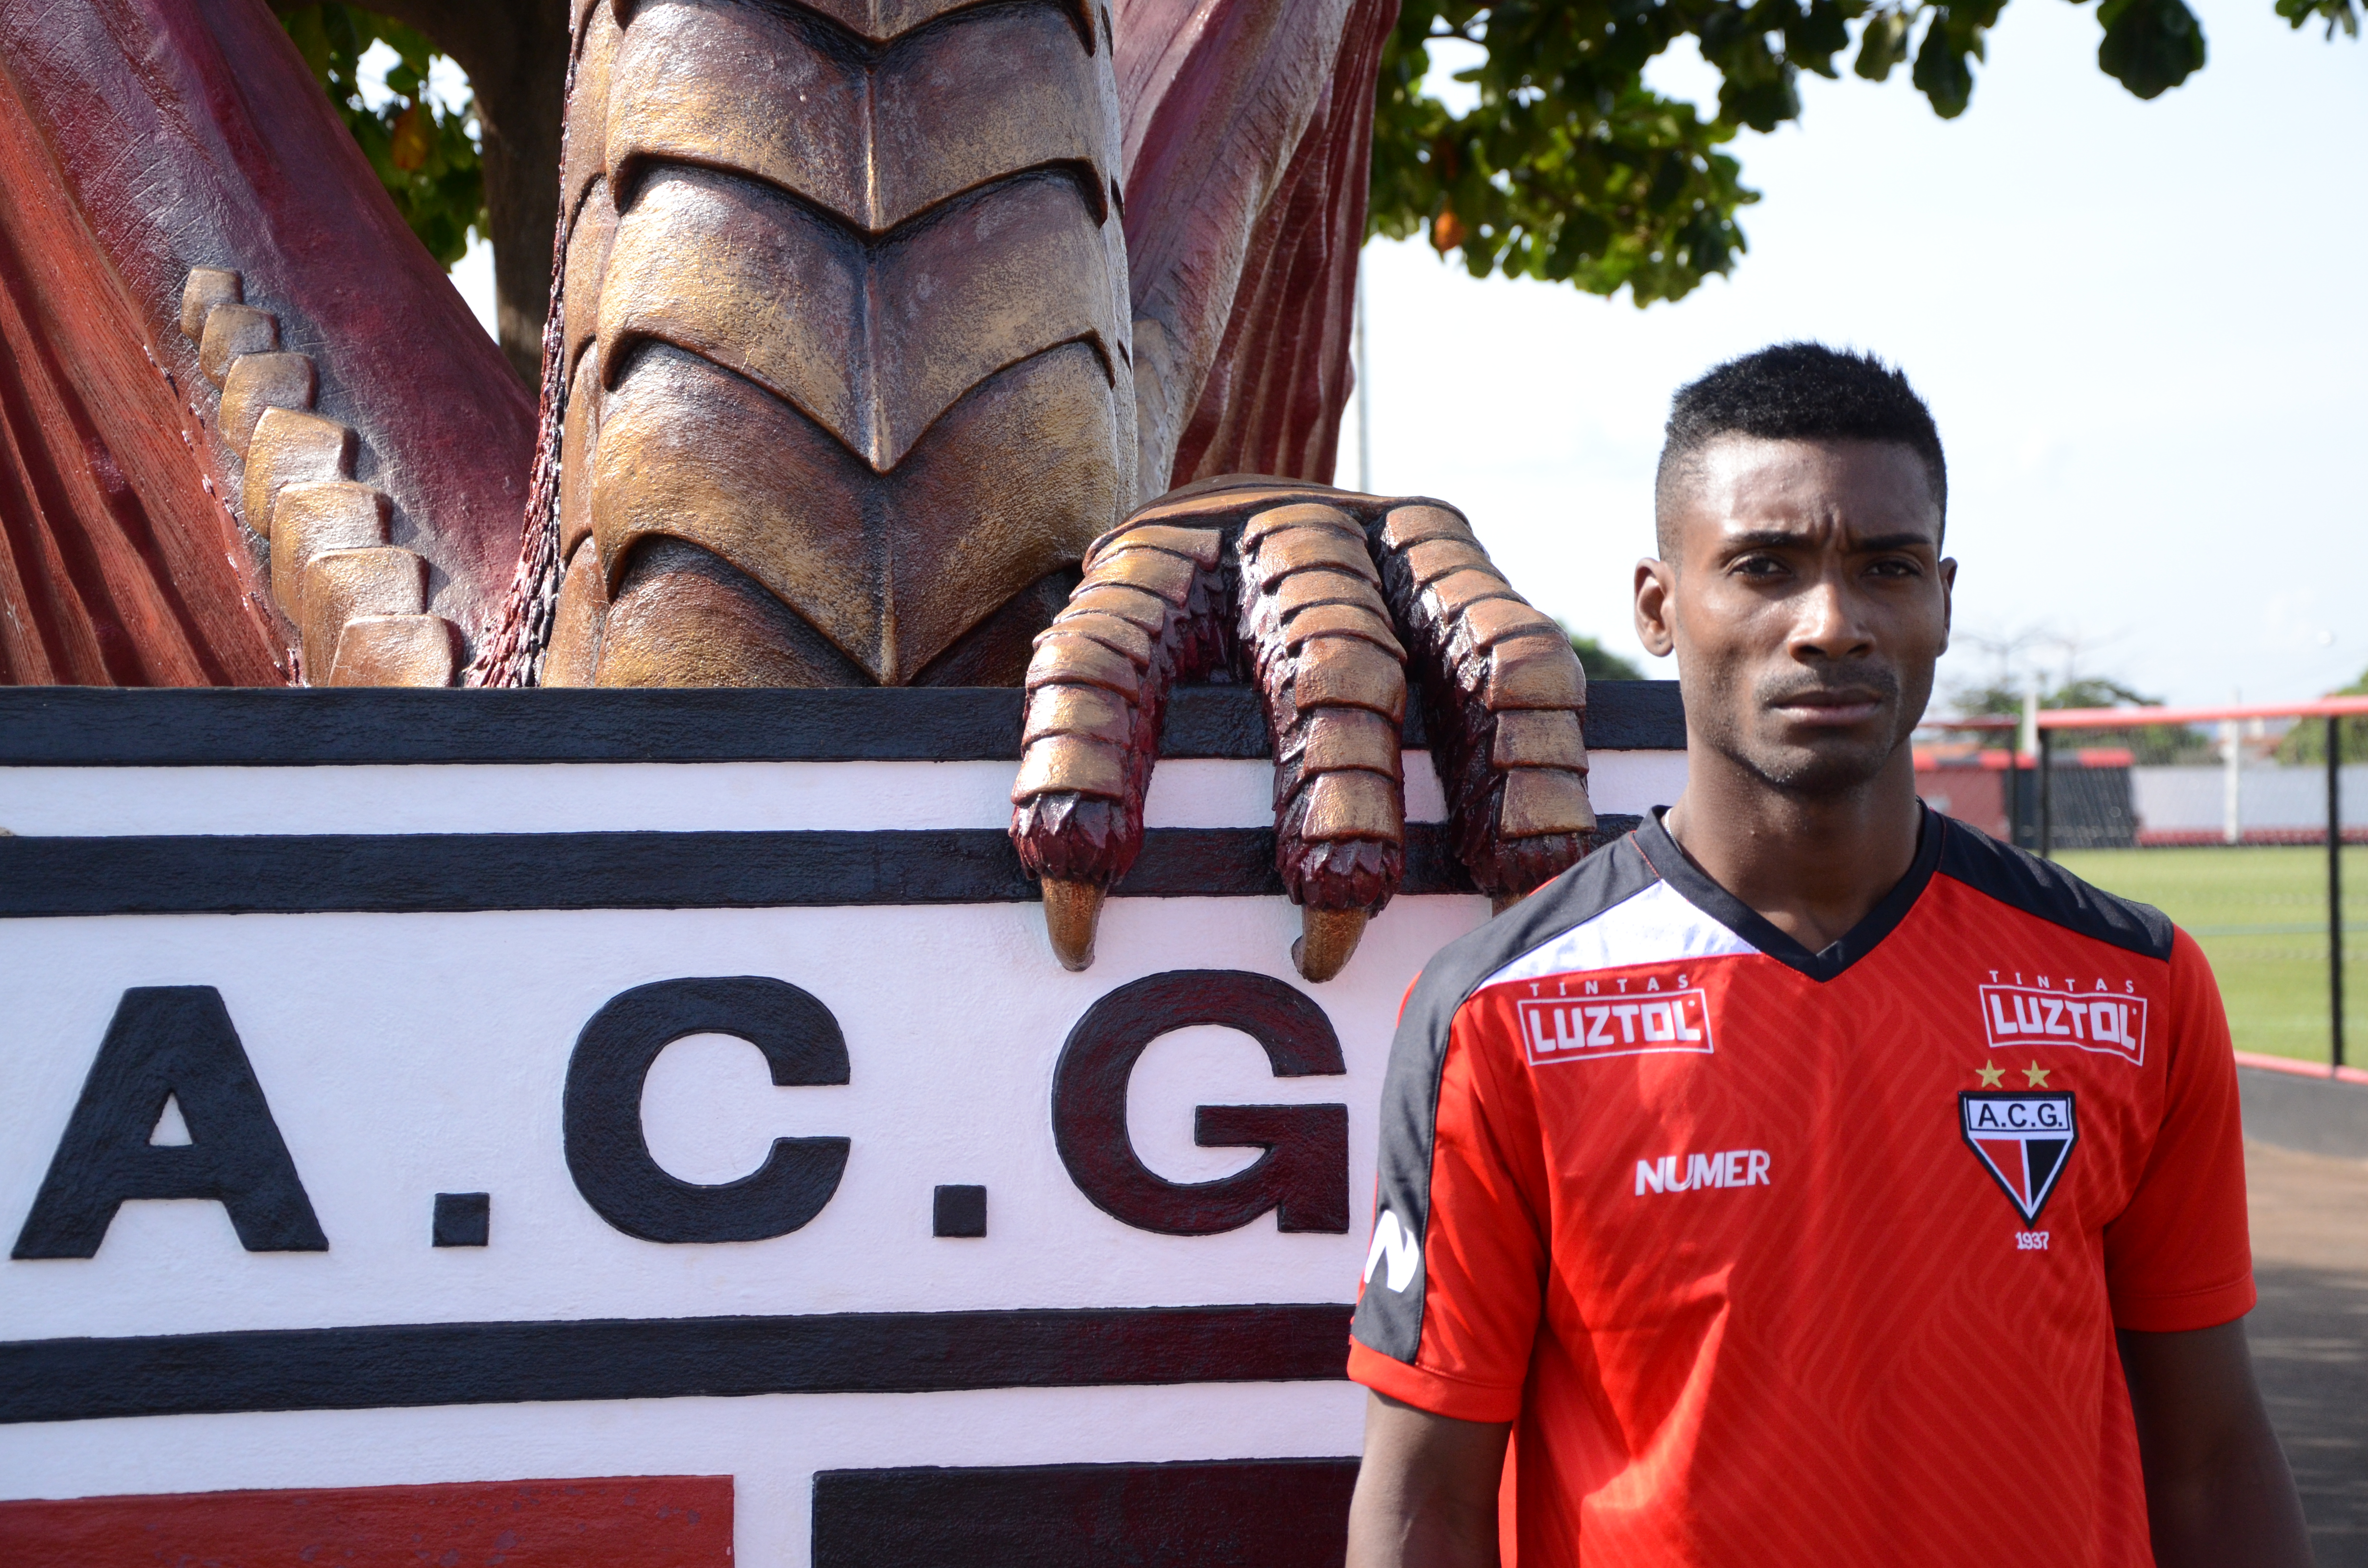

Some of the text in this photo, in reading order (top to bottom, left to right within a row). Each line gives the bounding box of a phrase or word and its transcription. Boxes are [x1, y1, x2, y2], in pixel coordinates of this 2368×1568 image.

[1530, 975, 1689, 997] TINTAS
[1989, 970, 2134, 993] TINTAS
[1529, 1001, 1702, 1052] LUZTOL
[1990, 994, 2136, 1051] LUZTOL
[1978, 1103, 2063, 1127] A.C.G.
[1635, 1150, 1770, 1196] NUMER
[2015, 1231, 2049, 1250] 1937
